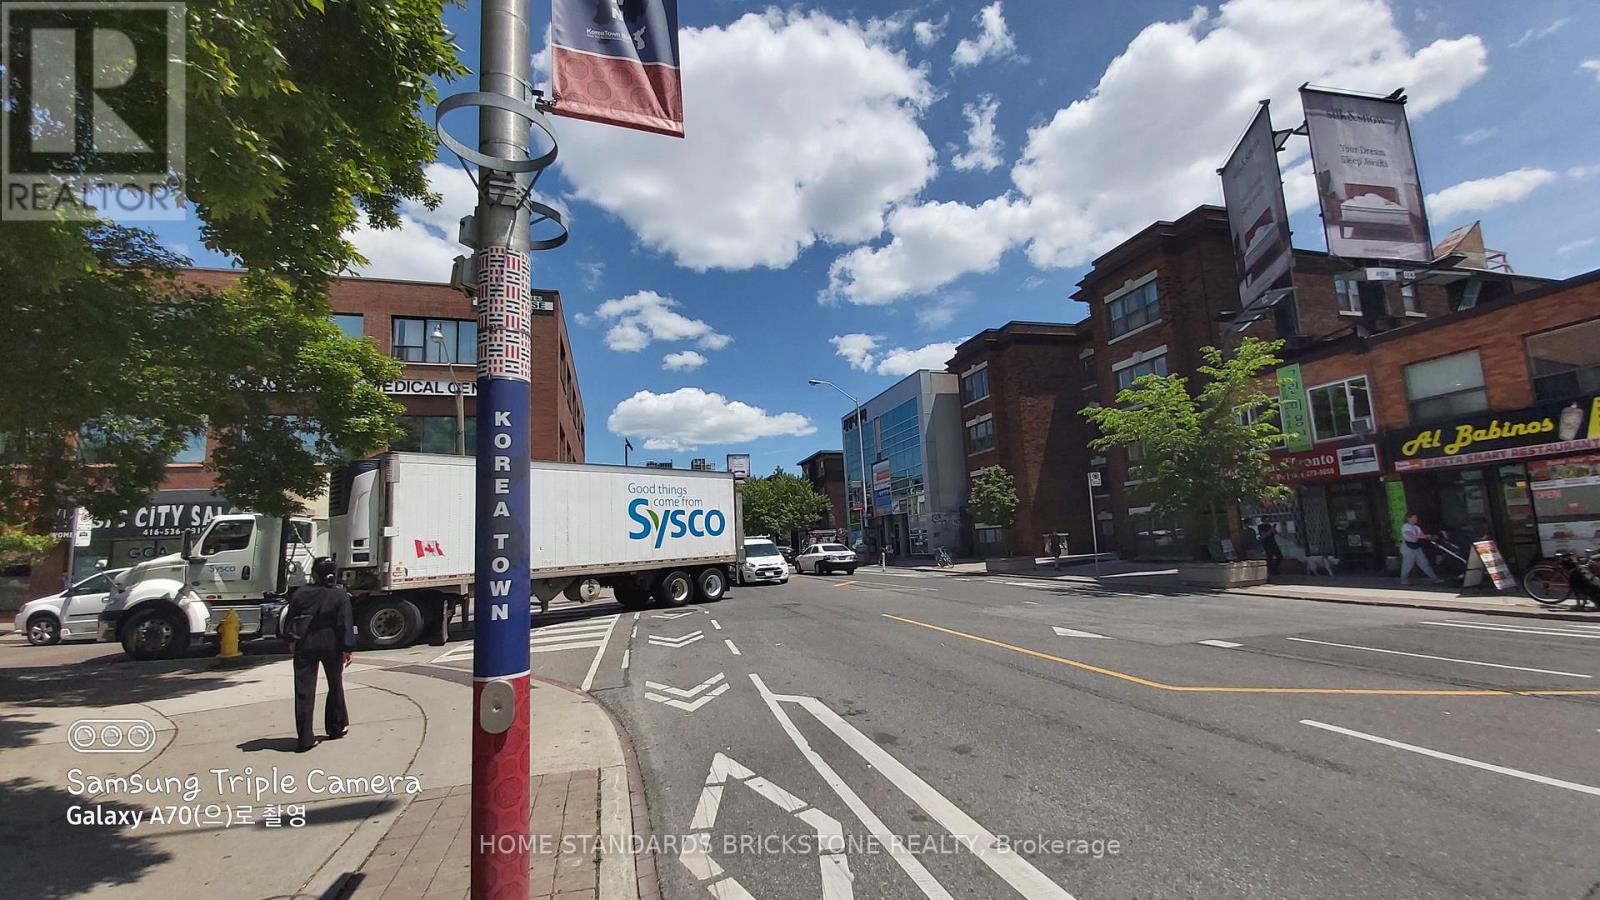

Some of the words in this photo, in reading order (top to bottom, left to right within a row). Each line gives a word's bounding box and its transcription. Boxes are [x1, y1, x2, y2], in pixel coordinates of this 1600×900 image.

[1339, 144, 1358, 154] Your
[1359, 146, 1386, 156] Dream
[1402, 428, 1442, 456] Al
[1443, 417, 1555, 455] Babinos
[493, 411, 512, 518] KOREA
[627, 482, 656, 494] Good
[658, 484, 688, 498] things
[653, 498, 680, 507] come
[682, 496, 703, 507] from
[489, 533, 512, 621] TOWN
